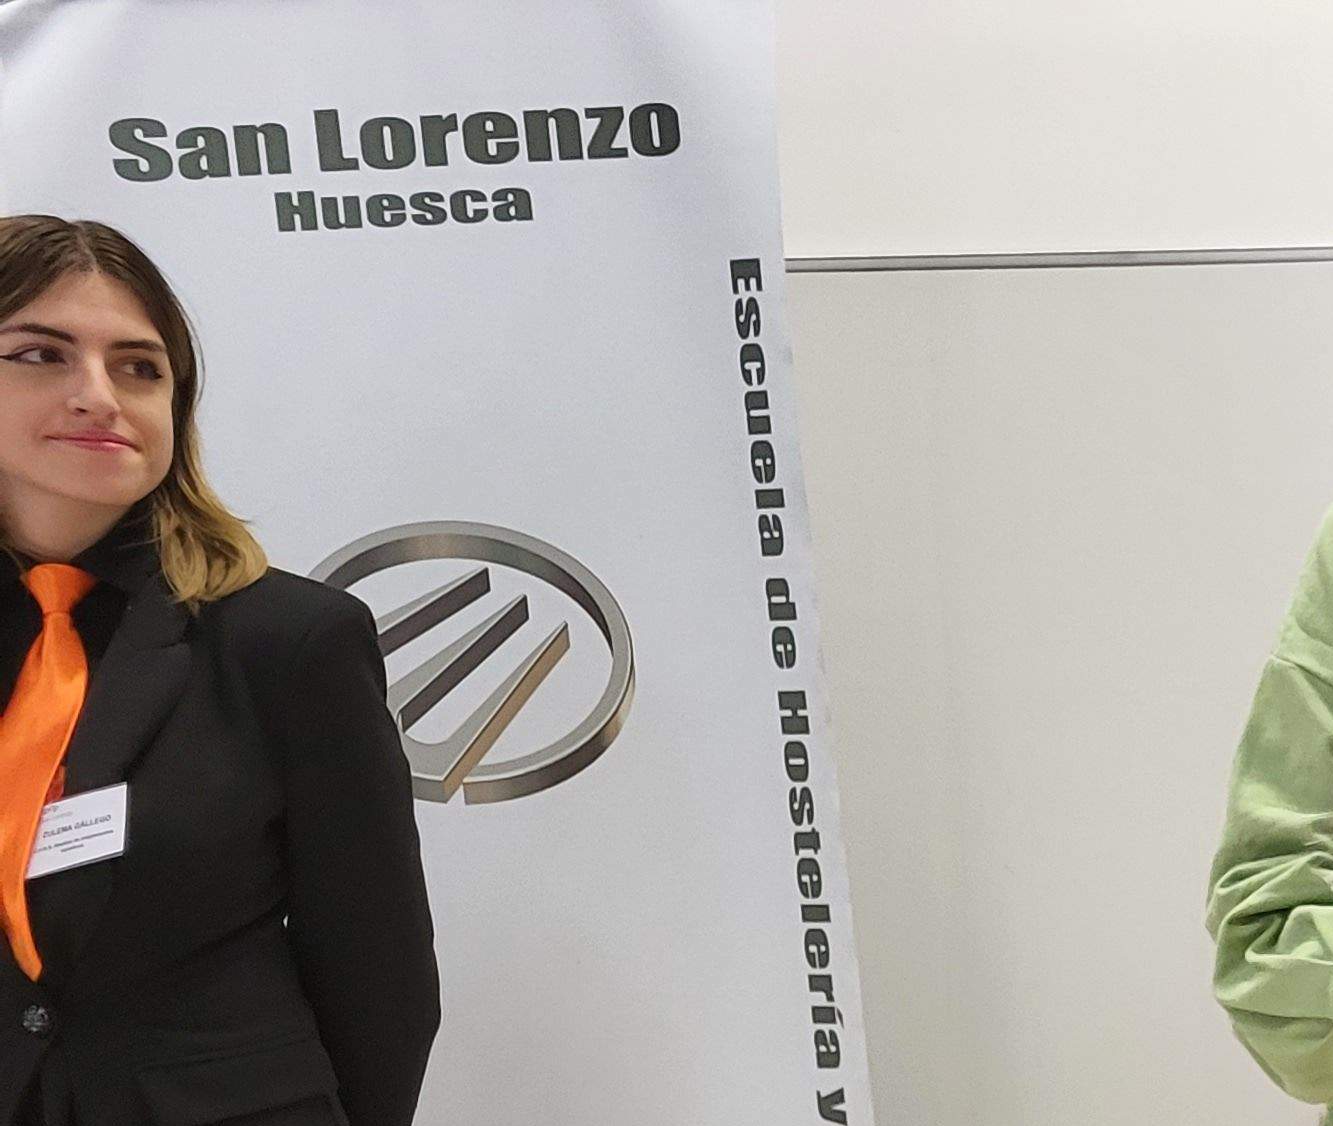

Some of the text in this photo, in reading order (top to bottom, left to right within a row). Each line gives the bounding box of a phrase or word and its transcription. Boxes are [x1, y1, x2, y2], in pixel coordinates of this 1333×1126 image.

[109, 103, 680, 182] San Lorenzo
[274, 188, 533, 232] Huesca
[730, 258, 786, 556] Escuela
[766, 578, 797, 669] de
[778, 691, 843, 1068] Hostelería
[817, 1088, 847, 1126] y
